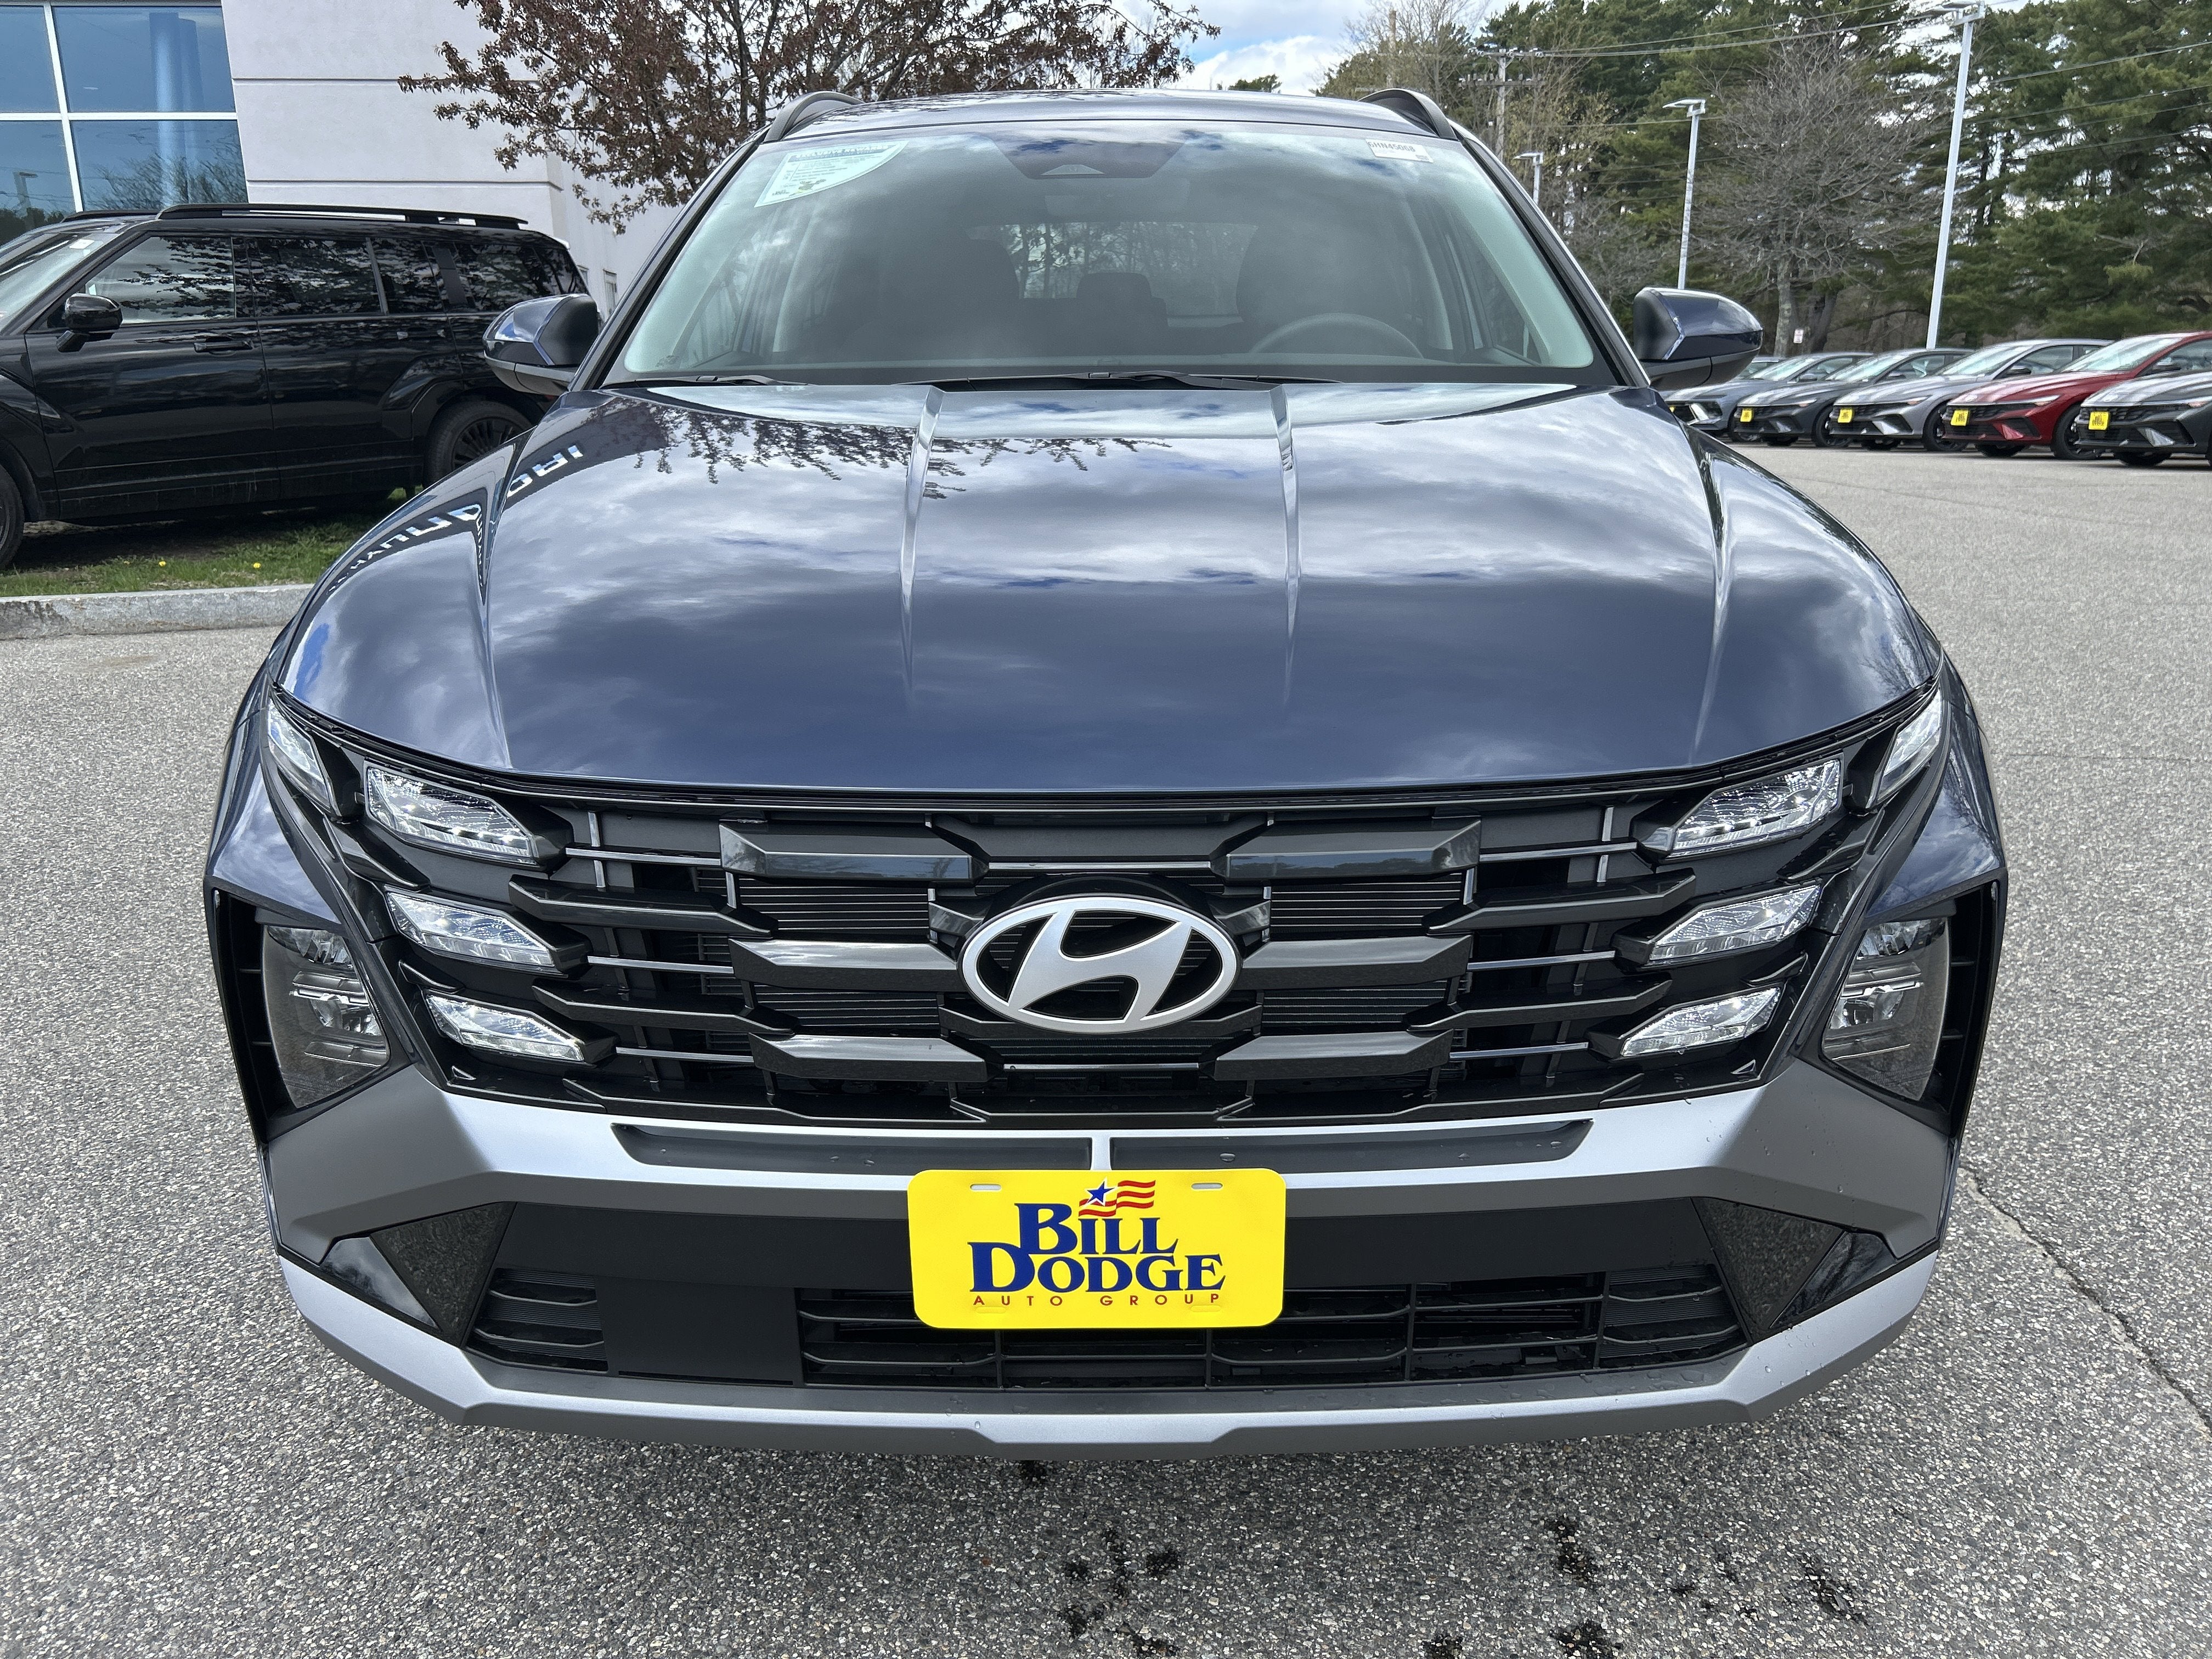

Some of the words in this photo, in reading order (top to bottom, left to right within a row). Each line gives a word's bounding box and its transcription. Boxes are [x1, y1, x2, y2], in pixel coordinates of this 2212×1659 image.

[1014, 1202, 1178, 1255] BILL
[967, 1241, 1226, 1293] DODGE
[973, 1295, 1063, 1306] AUTO
[1099, 1293, 1220, 1306] GROUP
